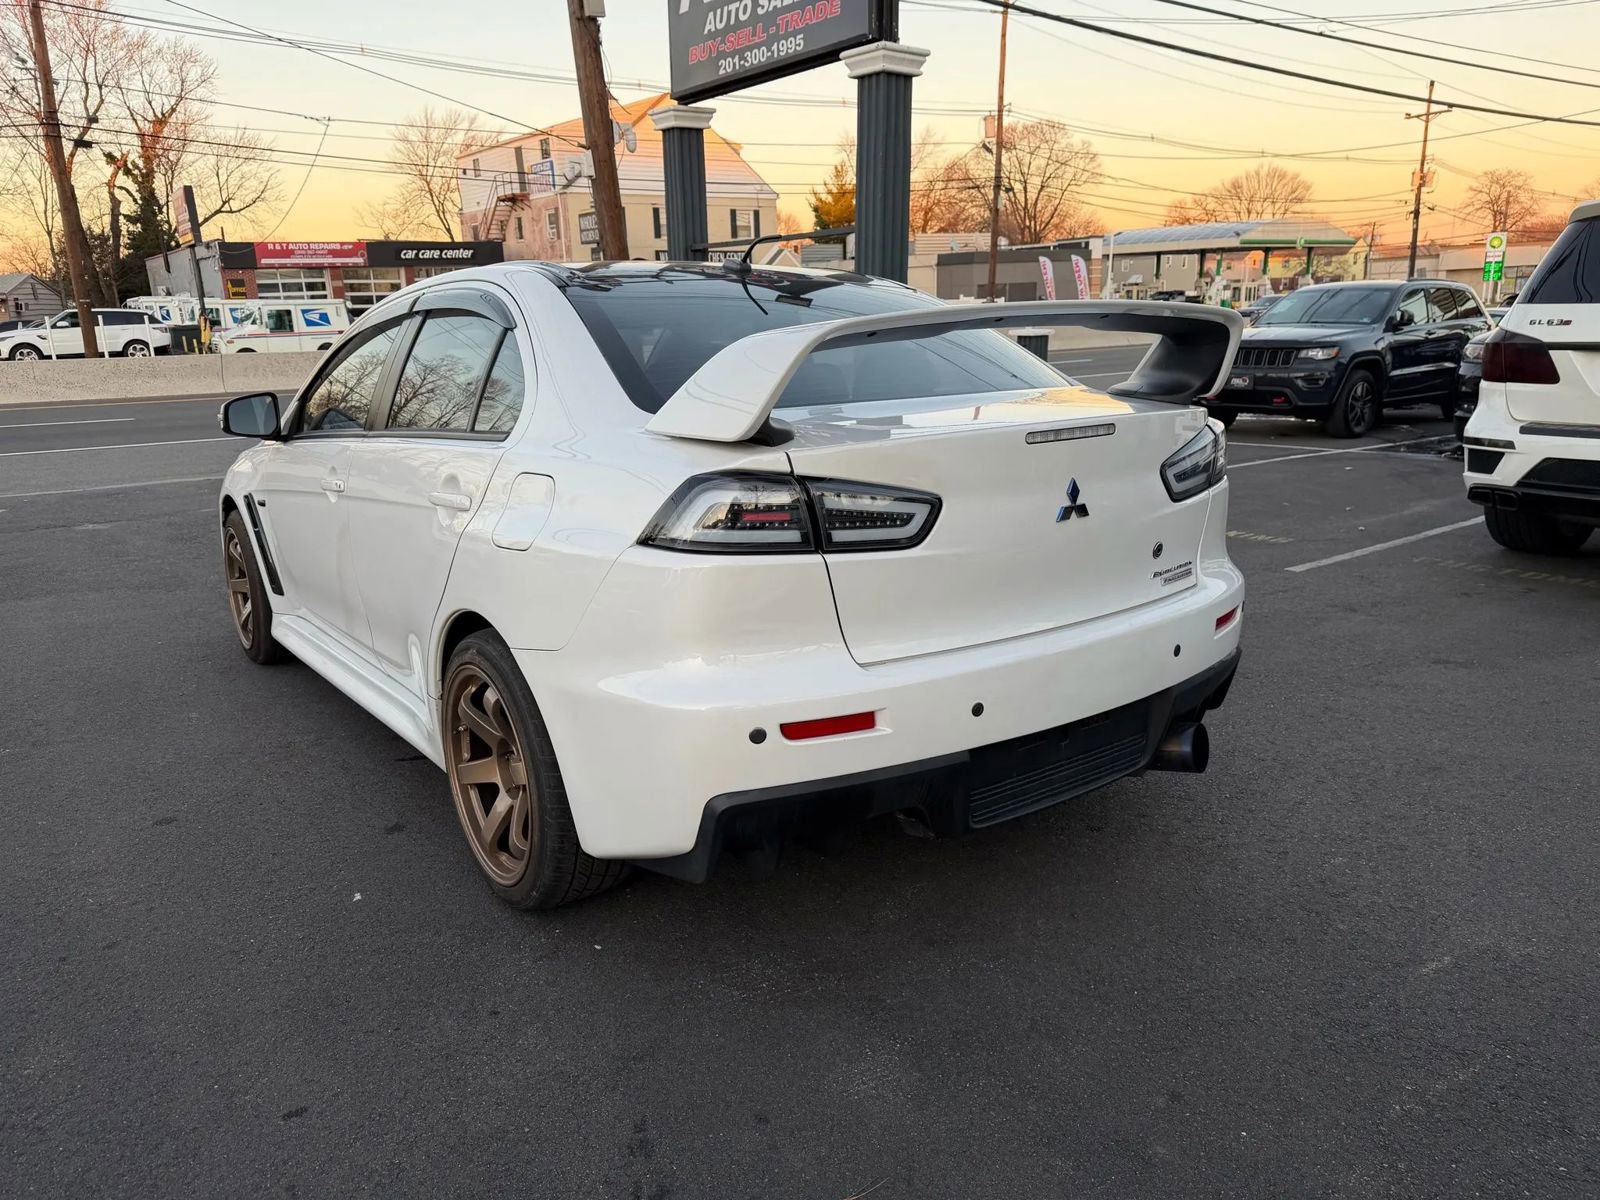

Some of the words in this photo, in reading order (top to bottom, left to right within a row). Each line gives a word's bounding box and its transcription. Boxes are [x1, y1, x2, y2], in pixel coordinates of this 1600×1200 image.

[704, 0, 752, 35] AUTO
[777, 0, 841, 35] TRADE
[718, 34, 805, 75] 201-300-1995
[400, 249, 417, 259] car
[419, 249, 440, 259] care
[442, 248, 474, 259] center
